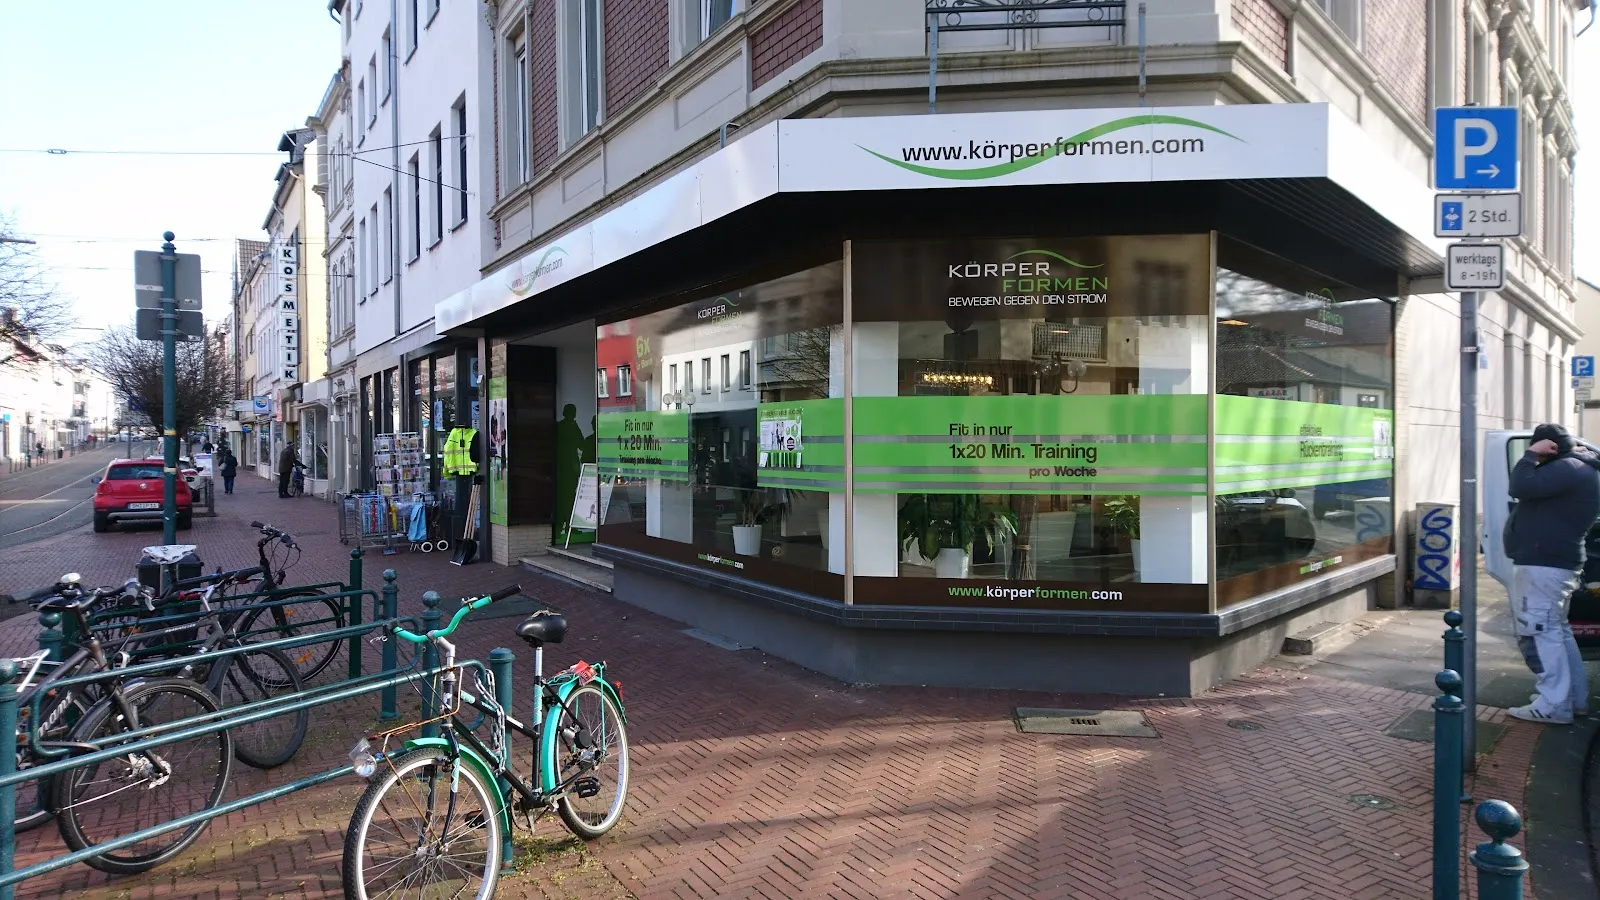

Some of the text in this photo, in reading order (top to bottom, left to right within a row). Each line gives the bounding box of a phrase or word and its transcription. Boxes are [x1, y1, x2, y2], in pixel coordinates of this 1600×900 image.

[902, 137, 1205, 164] www.körperformen.com
[1453, 118, 1499, 179] P
[1468, 209, 1512, 223] 2 Std.
[1455, 253, 1497, 267] werktags
[948, 261, 1050, 278] KÖRPER
[1003, 277, 1108, 293] FORMEN
[948, 294, 1107, 307] BEWEGEN GEGEN DEN STROM
[283, 249, 296, 379] KOSMETIK
[624, 419, 654, 432] Fit in nur
[949, 423, 1013, 437] Fit in nur
[630, 434, 641, 450] 20
[643, 434, 662, 451] Min.
[949, 443, 1098, 463] 1x20 Min. Training
[1029, 466, 1098, 479] pro Woche
[948, 585, 1123, 601] www.körperformen.com
